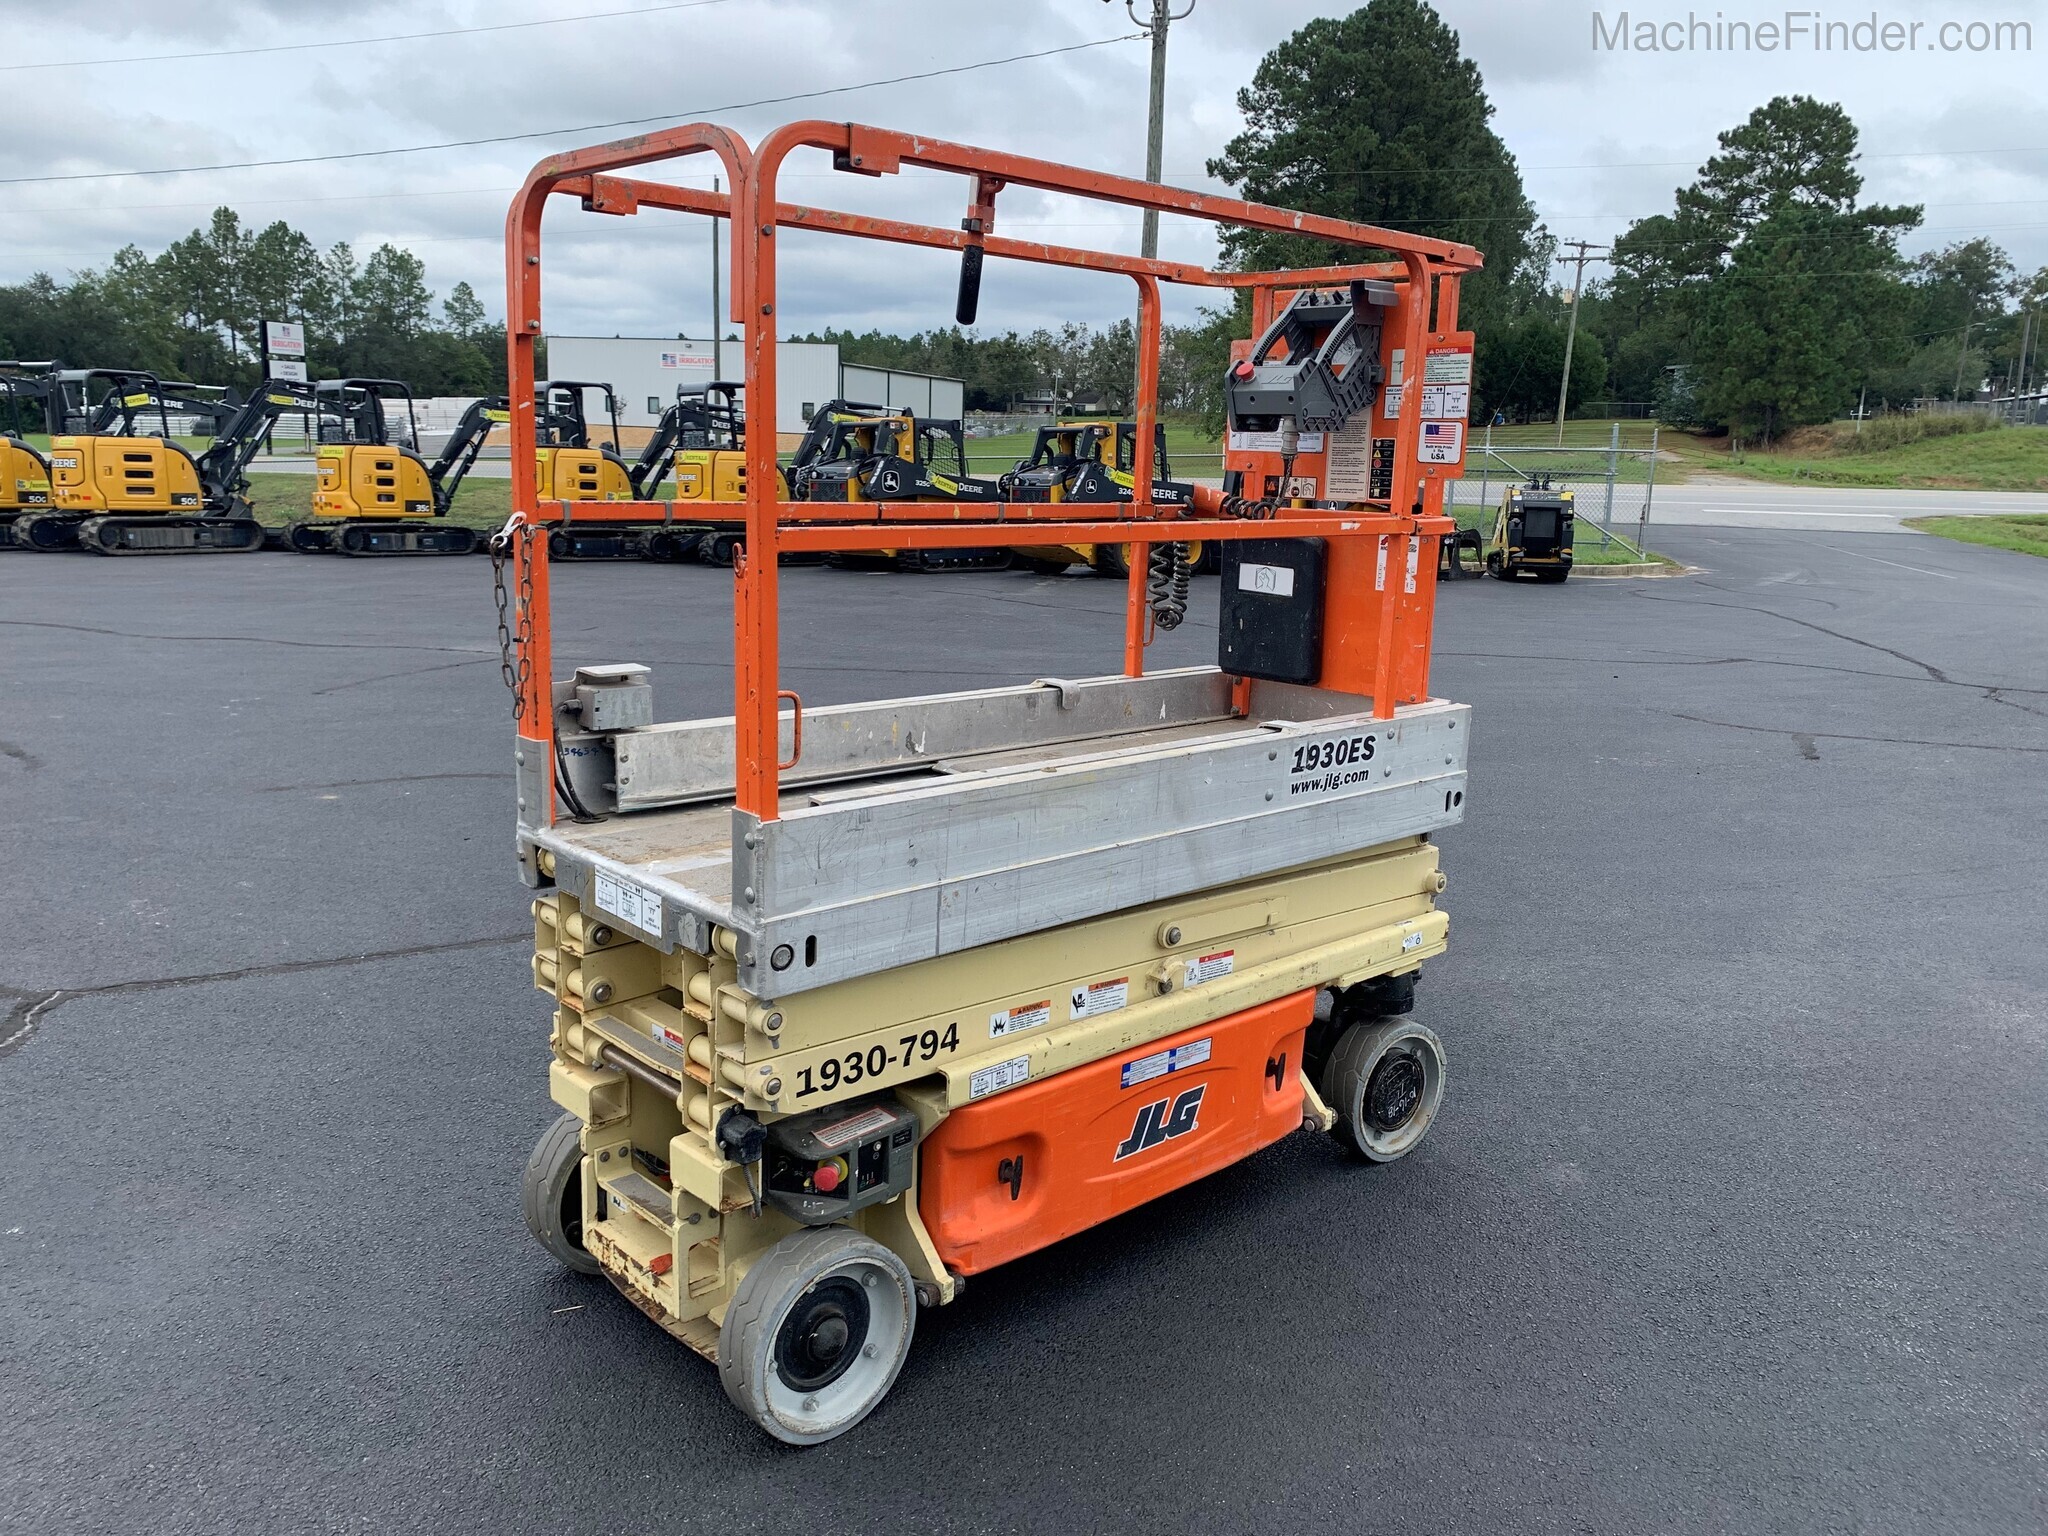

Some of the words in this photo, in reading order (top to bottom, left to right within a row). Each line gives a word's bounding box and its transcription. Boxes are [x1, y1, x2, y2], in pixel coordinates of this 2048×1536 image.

[271, 340, 302, 348] IRRIGATION
[1435, 347, 1459, 355] DANGER
[149, 396, 184, 409] DERE
[1430, 452, 1446, 461] USA
[958, 482, 984, 494] DEERE
[28, 495, 47, 504] 50G
[1151, 488, 1179, 500] EERE
[180, 497, 198, 506] 50G
[415, 504, 430, 513] 35G
[1291, 735, 1377, 774] 1930ES
[1291, 769, 1370, 795] www.jlg.com
[1021, 1001, 1043, 1012] WARNING
[796, 1022, 960, 1098] 1930-794
[1113, 1083, 1207, 1162] JLG
